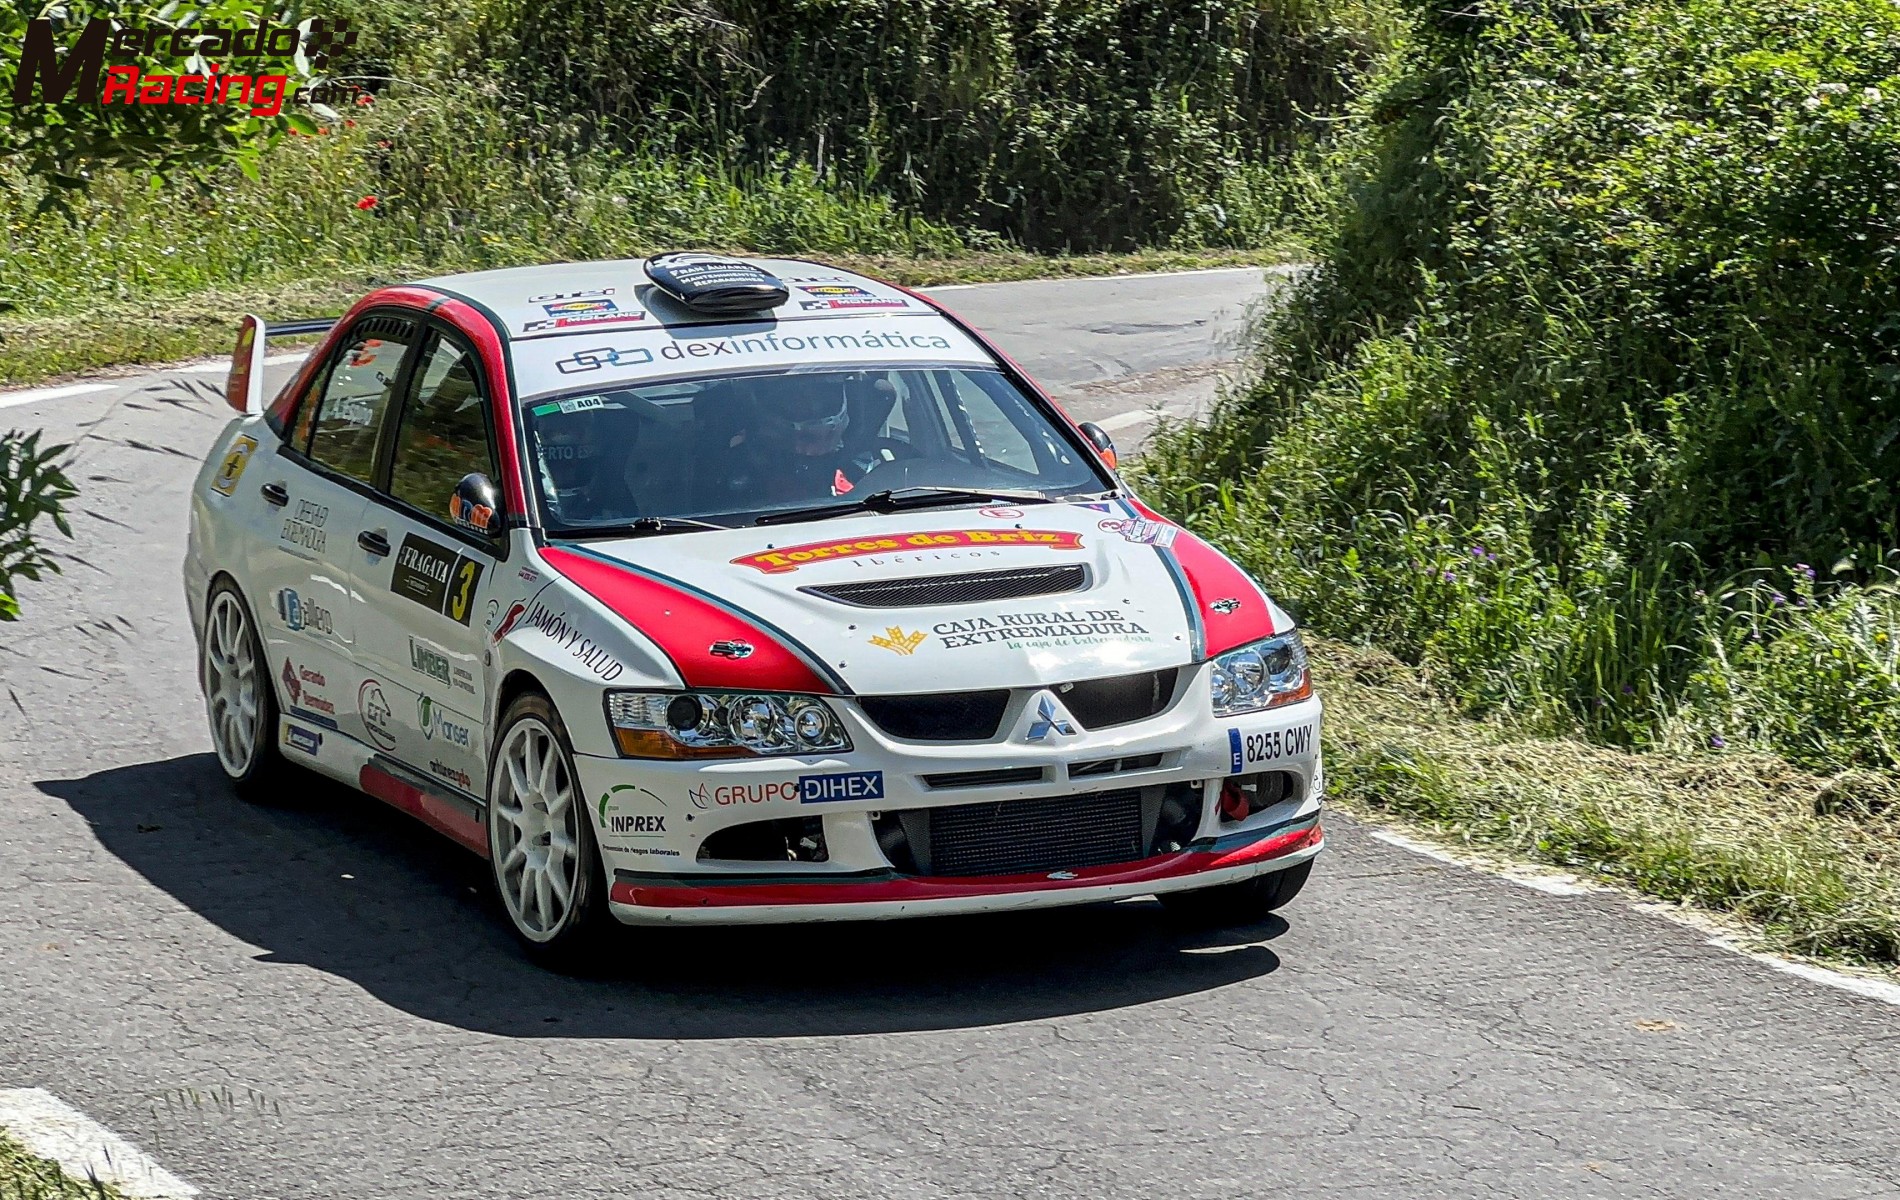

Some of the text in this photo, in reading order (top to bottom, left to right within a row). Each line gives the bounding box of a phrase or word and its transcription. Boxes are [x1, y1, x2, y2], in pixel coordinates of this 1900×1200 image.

[661, 330, 951, 360] dexinformática
[576, 398, 601, 408] A04
[755, 530, 1063, 567] Torres de Briz
[402, 546, 449, 584] FRAGATA
[453, 561, 475, 621] 3
[932, 610, 1125, 636] CAJA RURAL DE
[939, 622, 1149, 649] EXTREMADURA
[525, 601, 624, 682] JAMÓN Y SALUD
[1232, 752, 1241, 765] E
[1246, 724, 1313, 763] 8255 CWY
[714, 775, 879, 806] GRUPO DIHEX
[611, 815, 667, 832] INPREX
[649, 848, 680, 856] laborales
